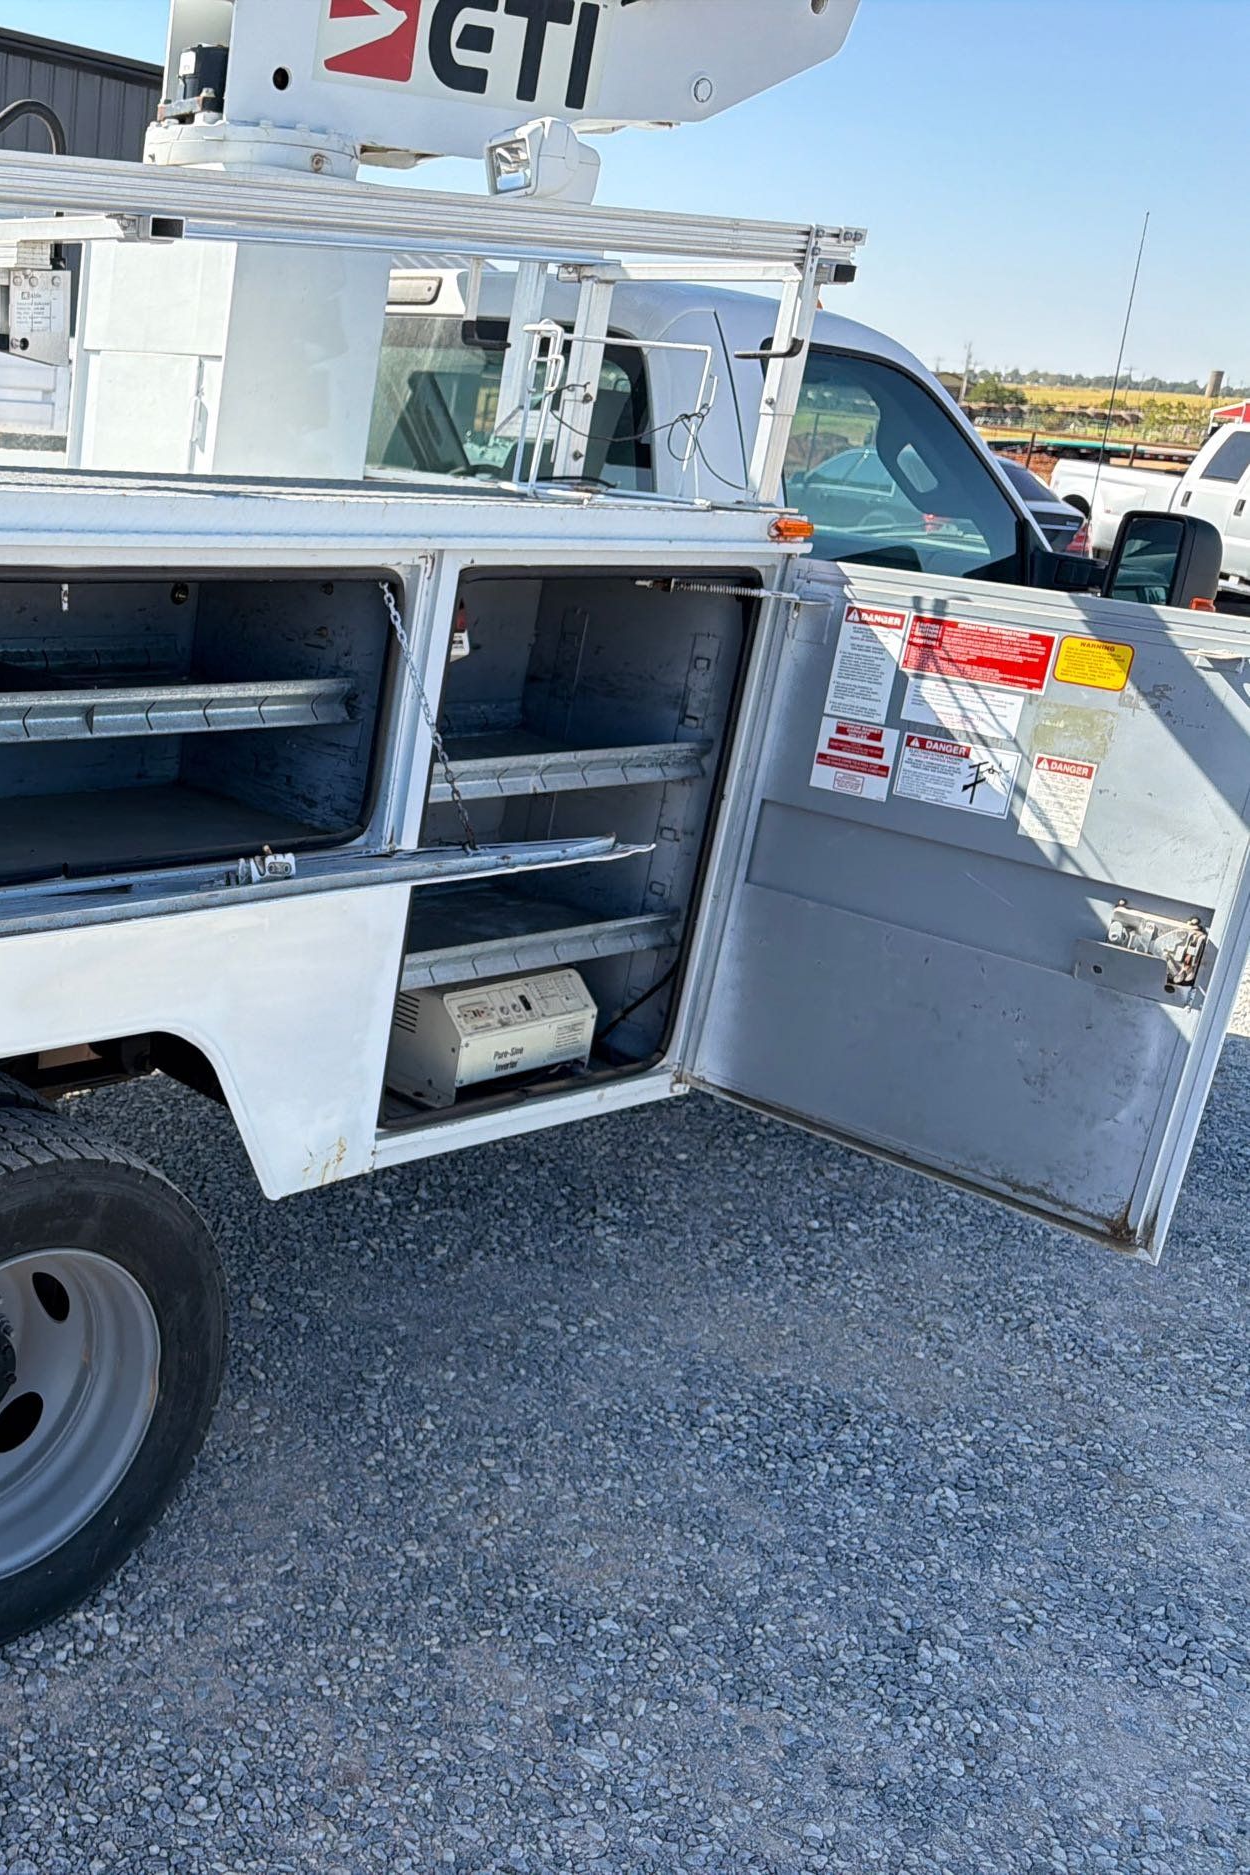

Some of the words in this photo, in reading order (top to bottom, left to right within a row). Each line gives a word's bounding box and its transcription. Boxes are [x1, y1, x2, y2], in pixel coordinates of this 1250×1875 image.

[429, 0, 600, 110] ETI
[860, 612, 902, 626] DANGER
[1080, 641, 1116, 653] WARNING
[925, 740, 967, 756] DANGER
[1050, 760, 1089, 777] DANGER
